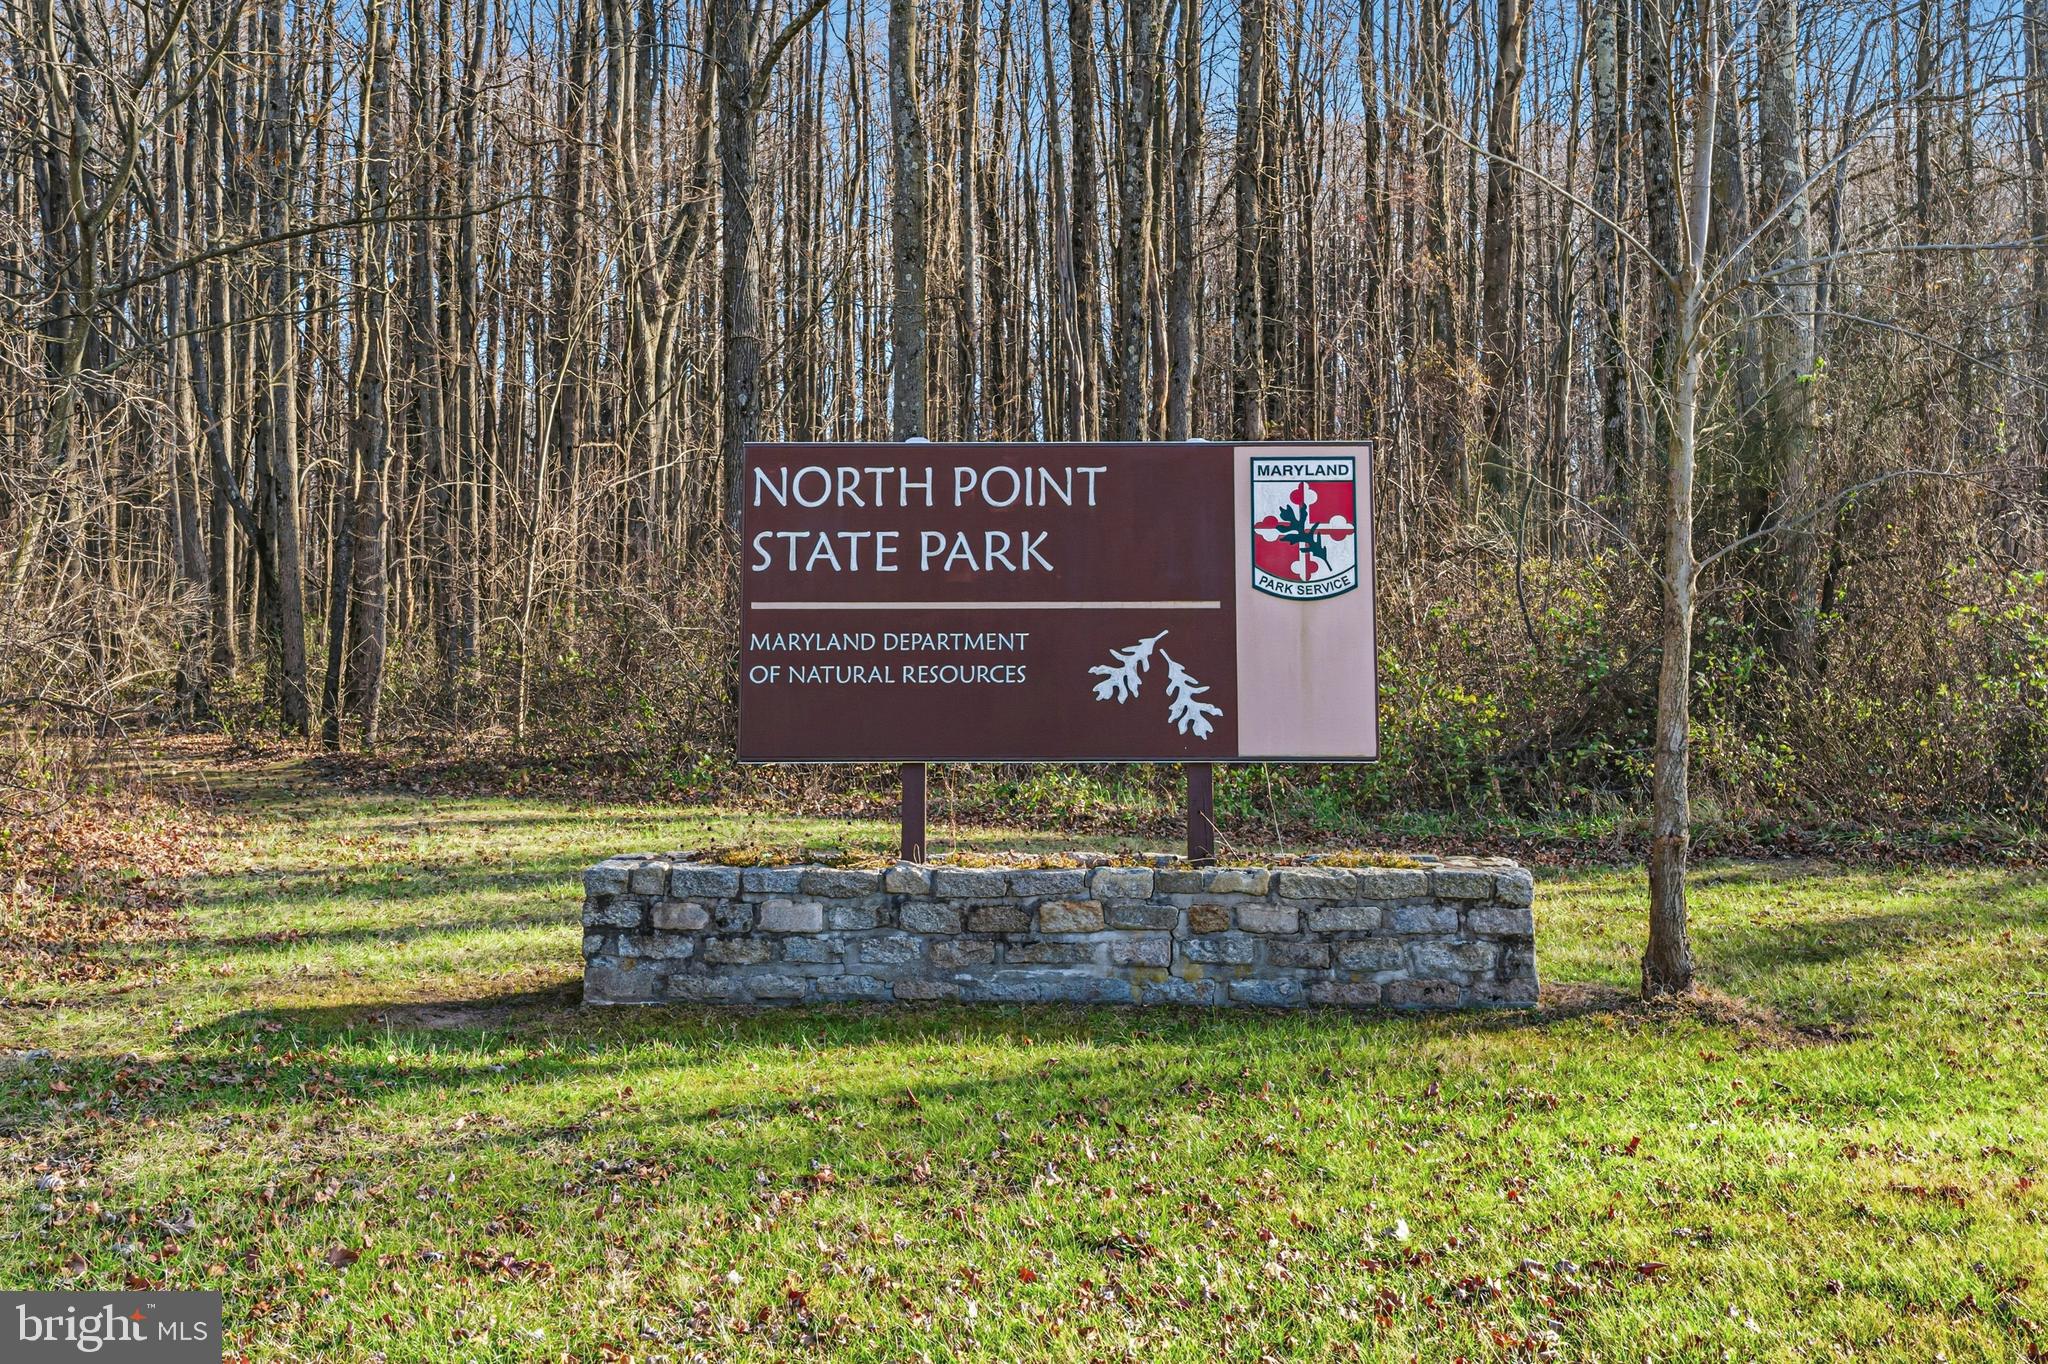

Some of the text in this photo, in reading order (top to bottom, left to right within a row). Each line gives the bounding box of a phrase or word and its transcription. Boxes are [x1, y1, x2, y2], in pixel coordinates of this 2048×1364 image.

[1257, 464, 1350, 476] MARYLAND
[753, 465, 1107, 508] NORTH POINT
[751, 530, 1054, 573] STATE PARK
[1259, 575, 1351, 596] PARK SERVICE
[750, 632, 1029, 652] MARYLAND DEPARTMENT
[749, 665, 1027, 684] OF NATURAL RESOURCES
